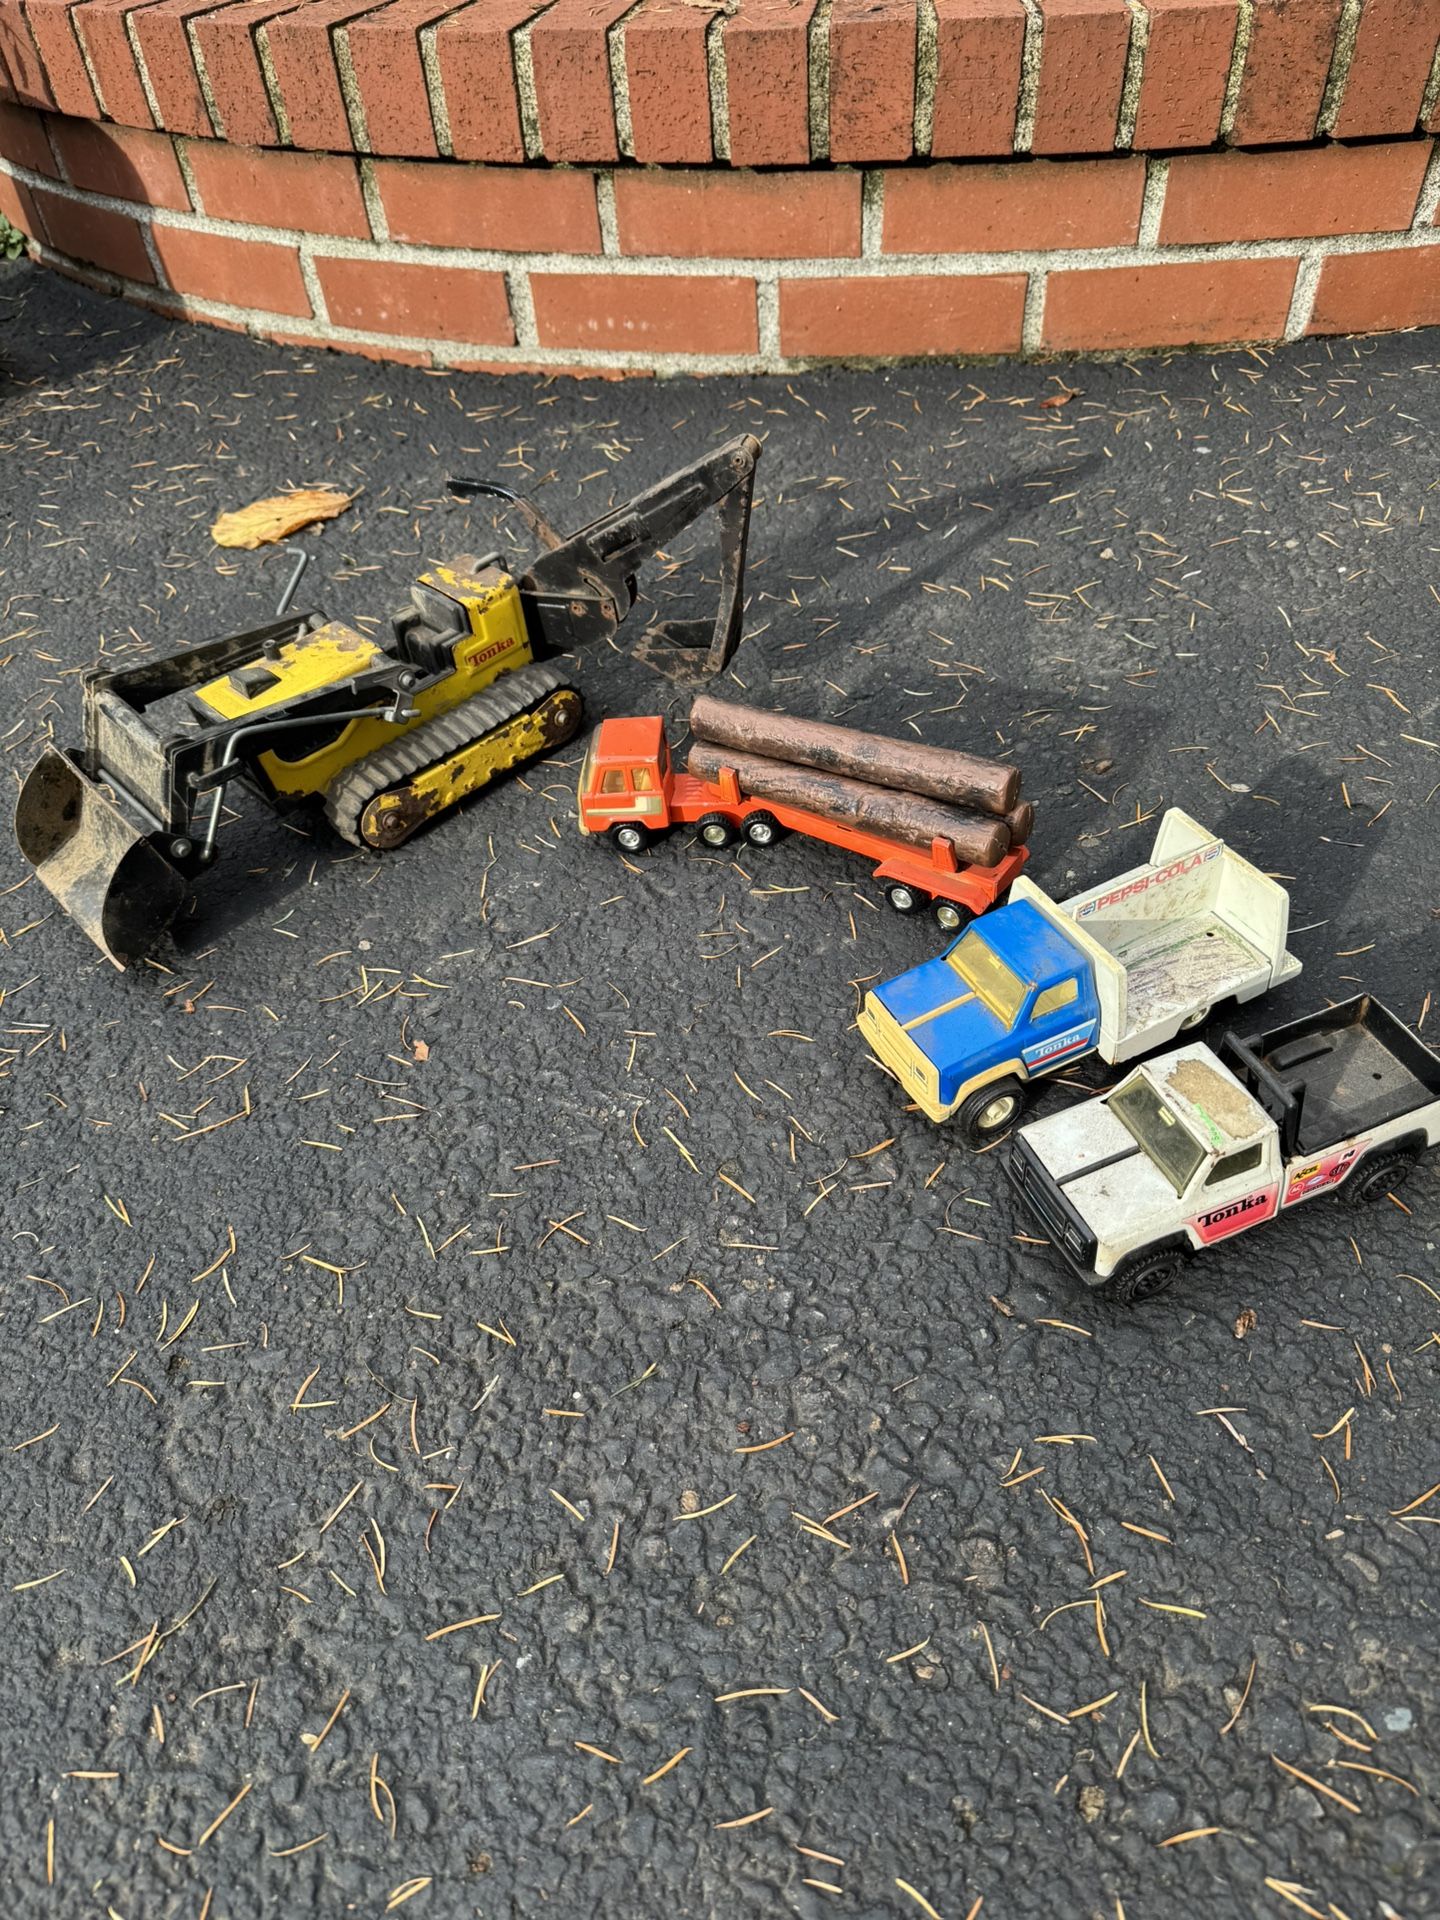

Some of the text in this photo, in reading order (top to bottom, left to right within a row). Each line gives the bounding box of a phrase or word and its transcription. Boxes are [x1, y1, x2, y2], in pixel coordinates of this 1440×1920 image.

[468, 637, 514, 667] Tonka
[1097, 853, 1202, 910] PEPSI-COLA
[1035, 1034, 1081, 1058] Tonka
[1198, 1194, 1268, 1228] Tonka
